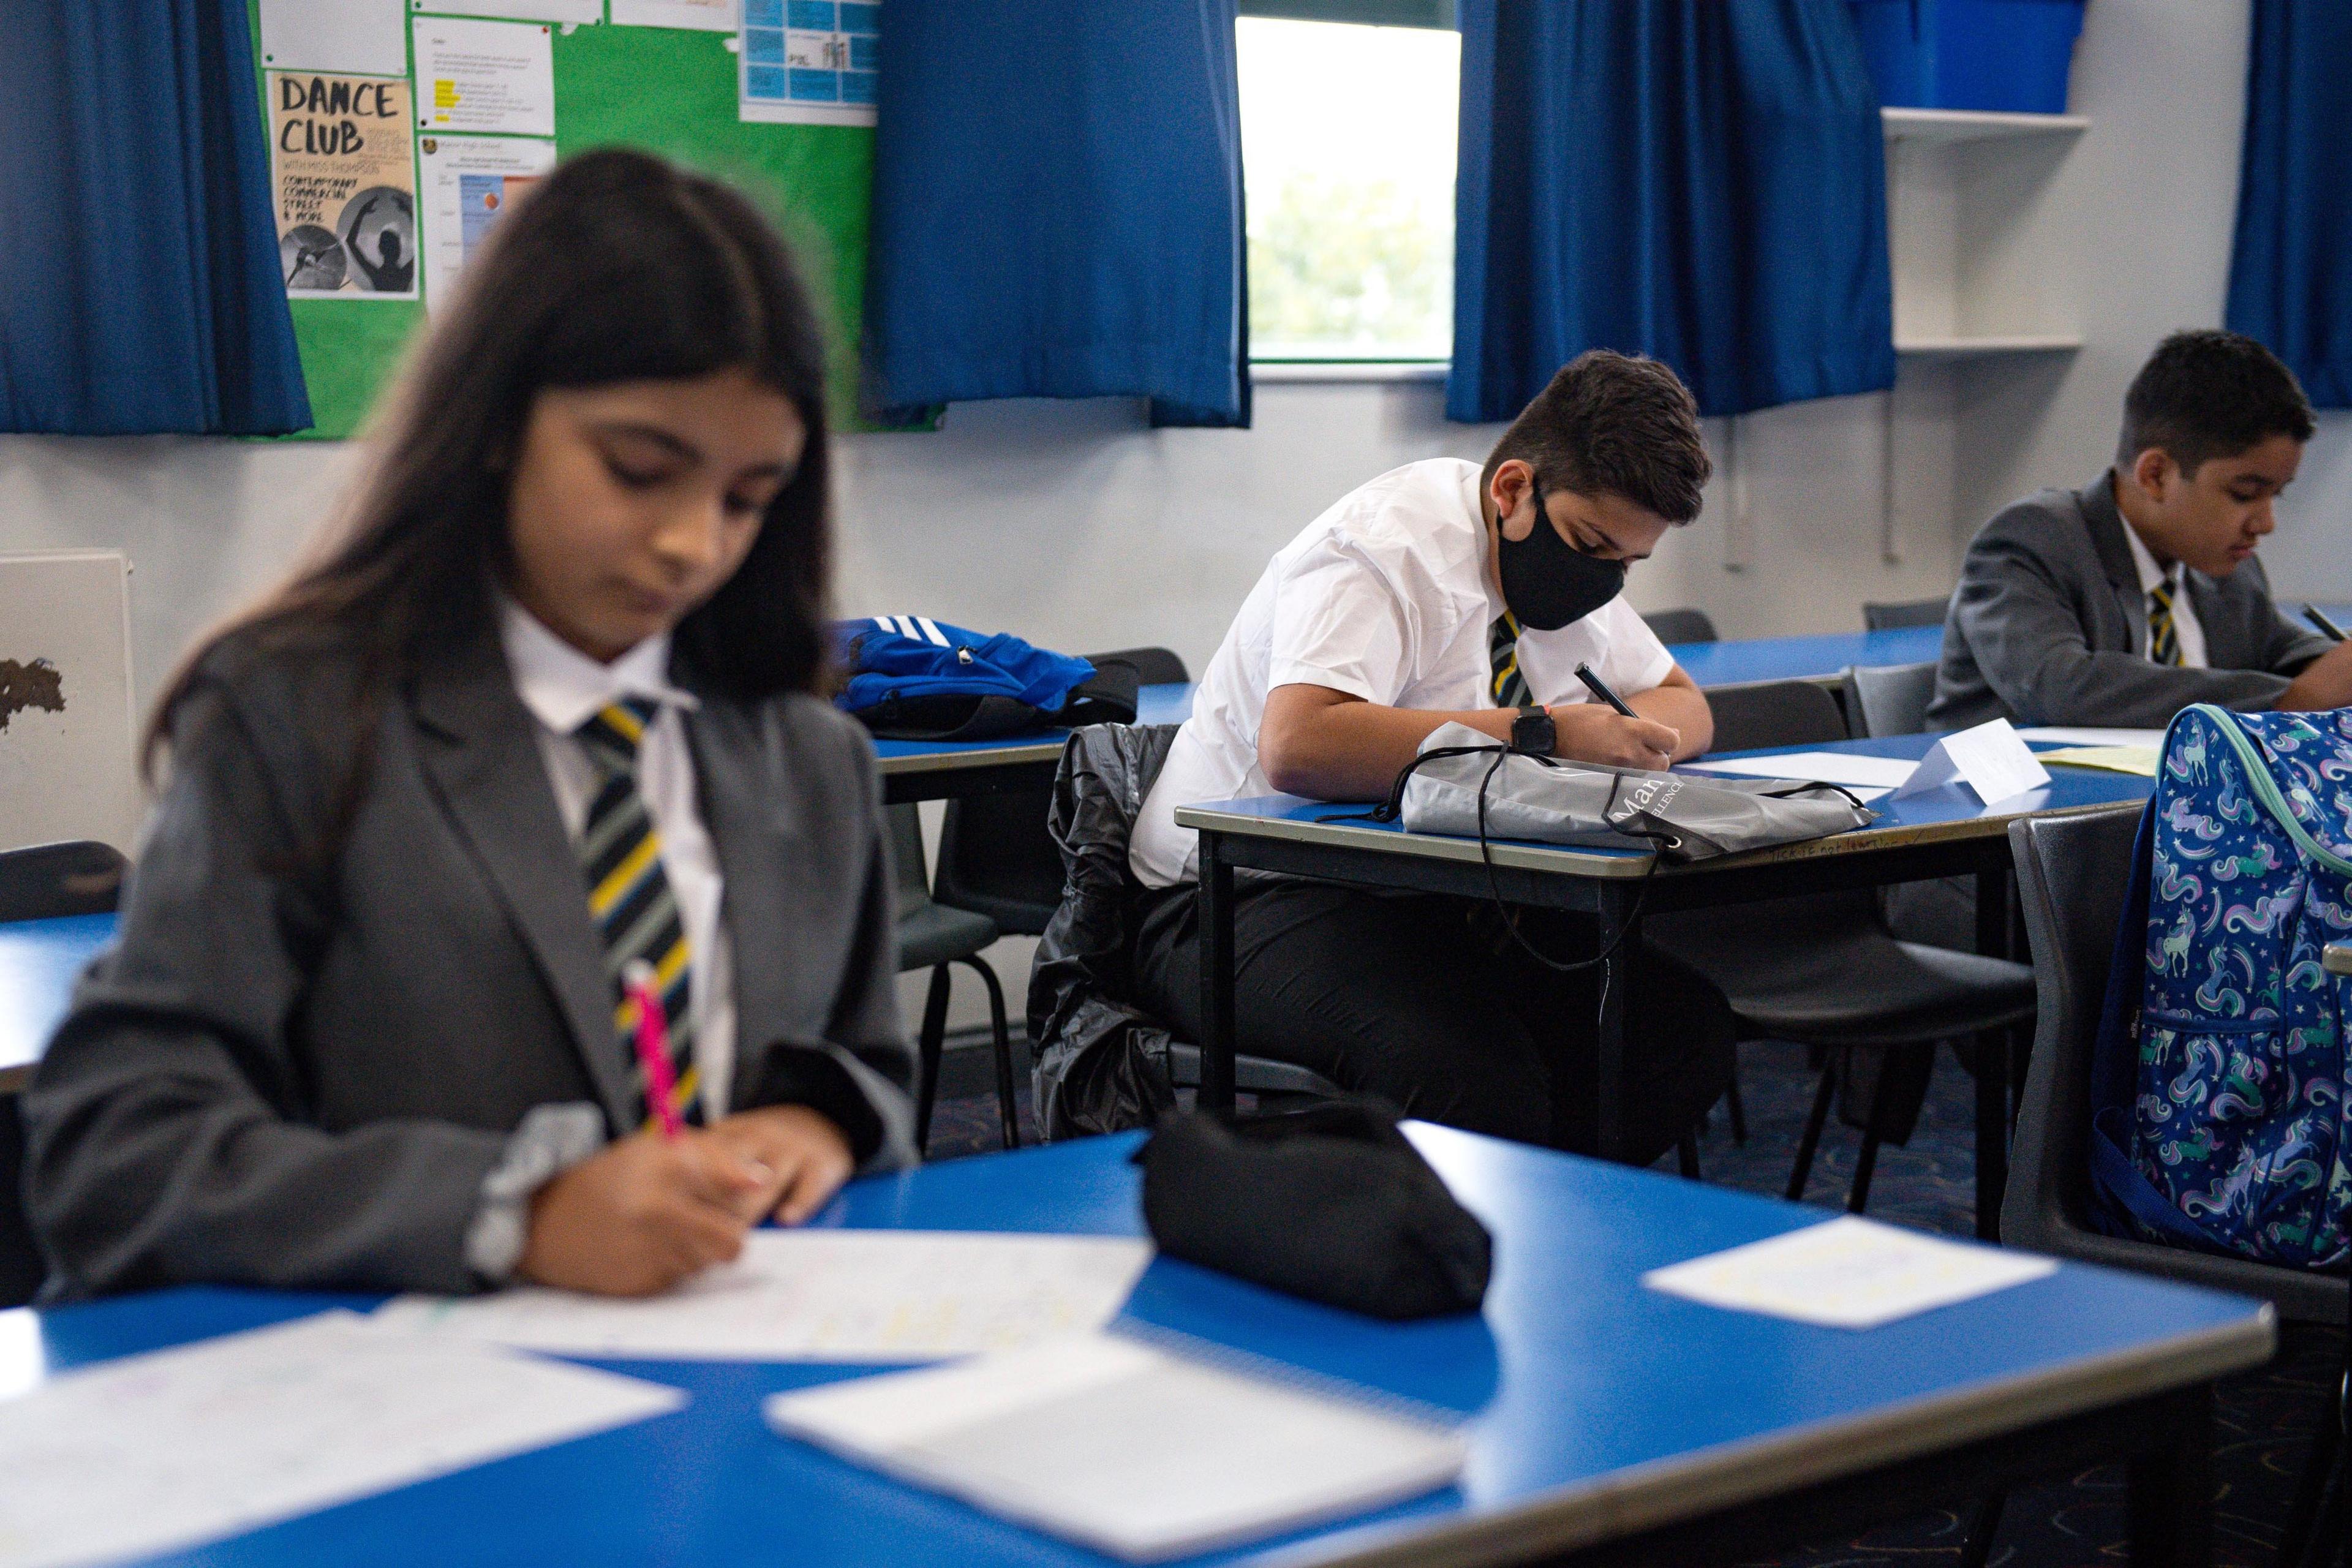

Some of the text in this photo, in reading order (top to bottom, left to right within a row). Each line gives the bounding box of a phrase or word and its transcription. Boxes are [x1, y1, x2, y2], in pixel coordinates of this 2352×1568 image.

[281, 77, 398, 118] DANCE
[281, 119, 363, 154] CLUB
[284, 176, 358, 188] CONTEMPORARY
[284, 198, 323, 209] STREET
